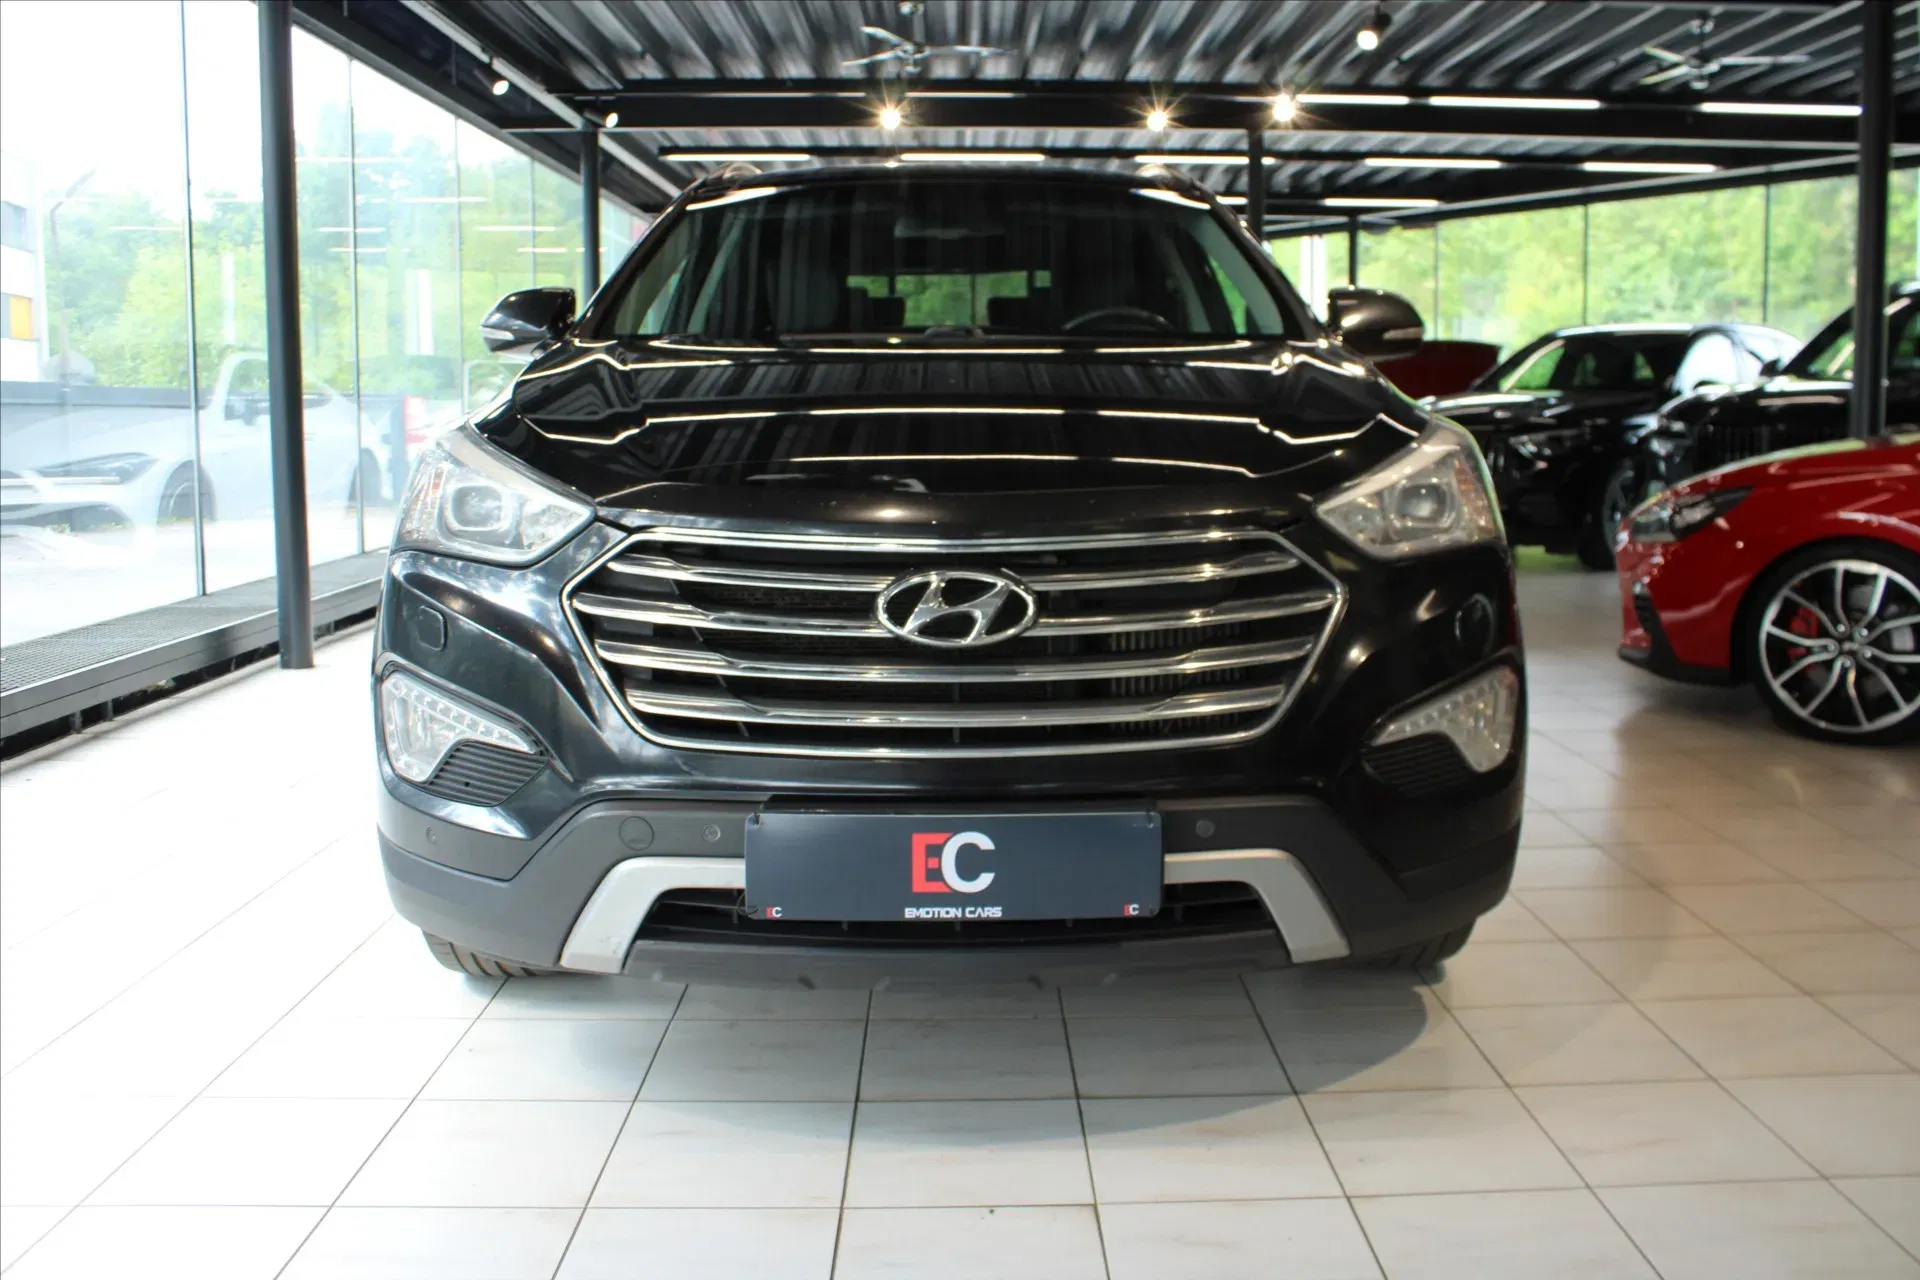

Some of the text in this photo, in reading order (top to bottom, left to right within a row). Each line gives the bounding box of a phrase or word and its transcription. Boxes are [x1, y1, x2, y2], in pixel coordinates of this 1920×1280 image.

[911, 831, 996, 894] EC
[904, 906, 1003, 919] EMOTION CARS
